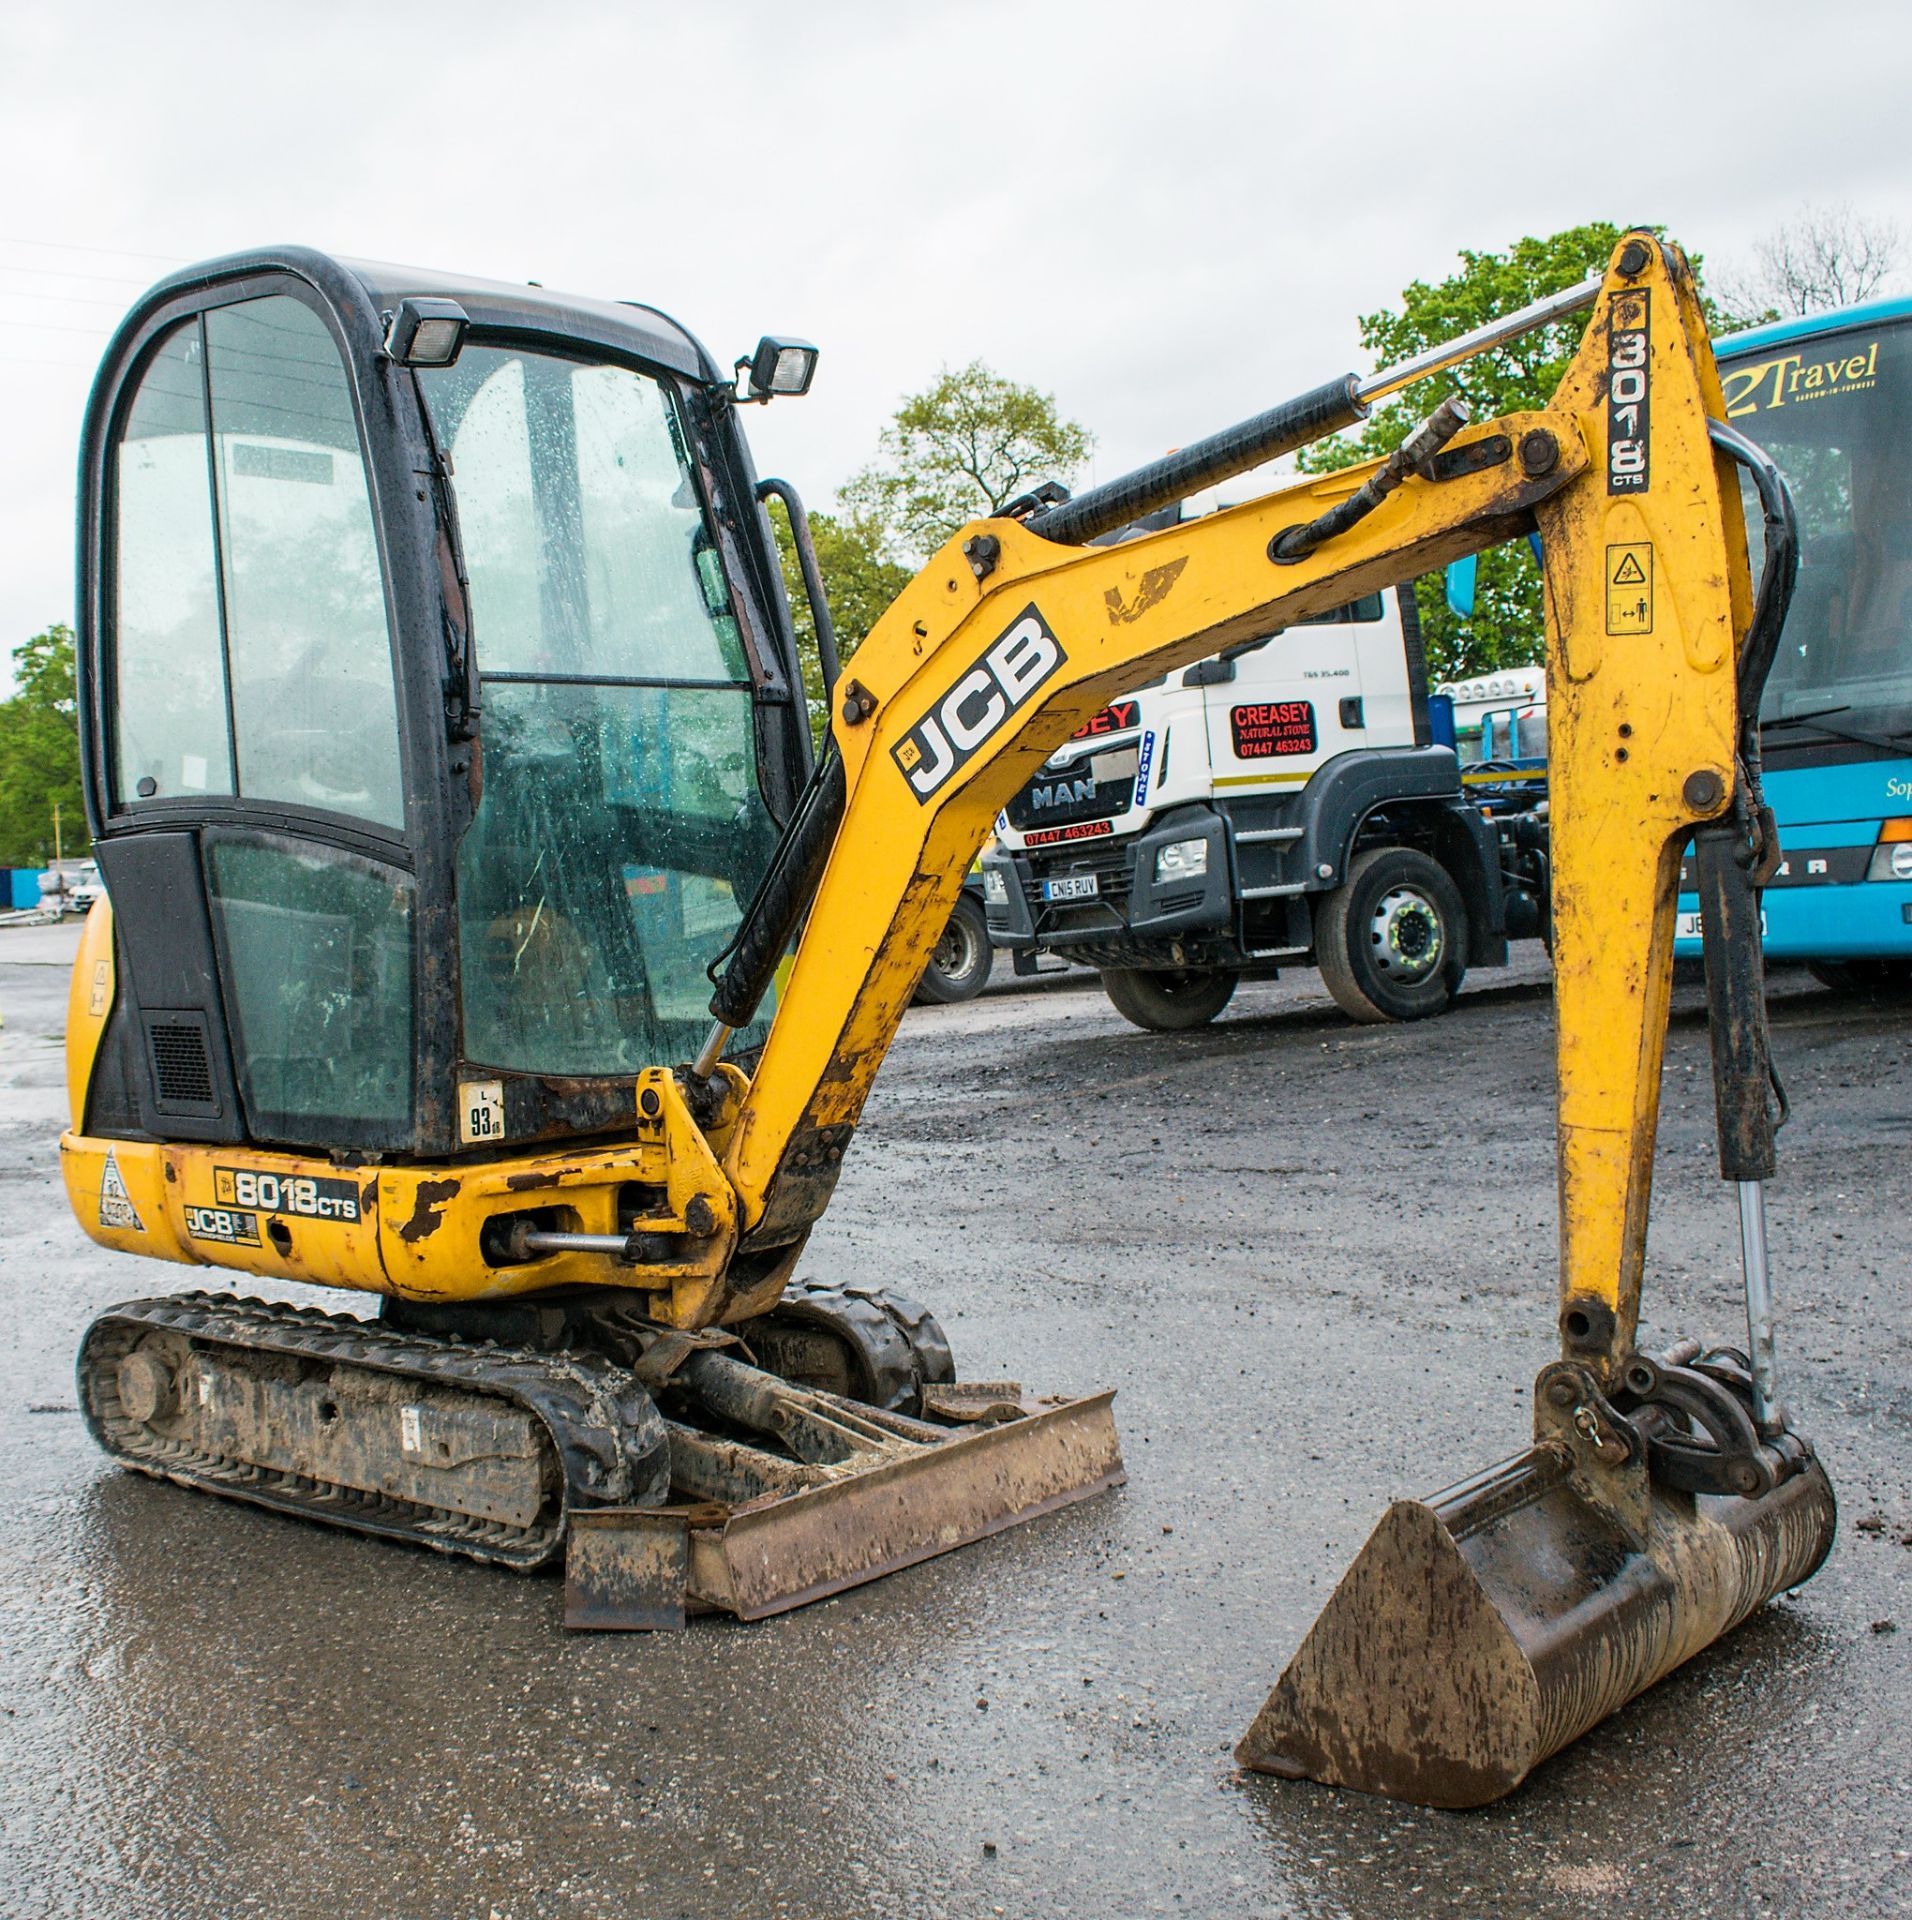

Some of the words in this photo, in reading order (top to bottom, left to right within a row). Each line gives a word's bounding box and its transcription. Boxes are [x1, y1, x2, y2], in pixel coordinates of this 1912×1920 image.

[1612, 473, 1643, 487] CTS
[911, 617, 1058, 793] JCB
[1235, 702, 1309, 727] CREASEY
[1240, 727, 1282, 740] NATURAL
[1283, 723, 1311, 737] STONE
[1241, 742, 1273, 757] 07447
[1275, 738, 1312, 754] 463243
[1138, 742, 1152, 793] STONE
[1032, 778, 1096, 810] MAN
[1026, 830, 1061, 845] 07447
[1065, 821, 1111, 838] 463243
[1051, 881, 1073, 897] CN15
[1075, 878, 1095, 894] RUV
[481, 1091, 487, 1100] L
[471, 1107, 491, 1136] 93
[187, 1208, 234, 1235] JCB
